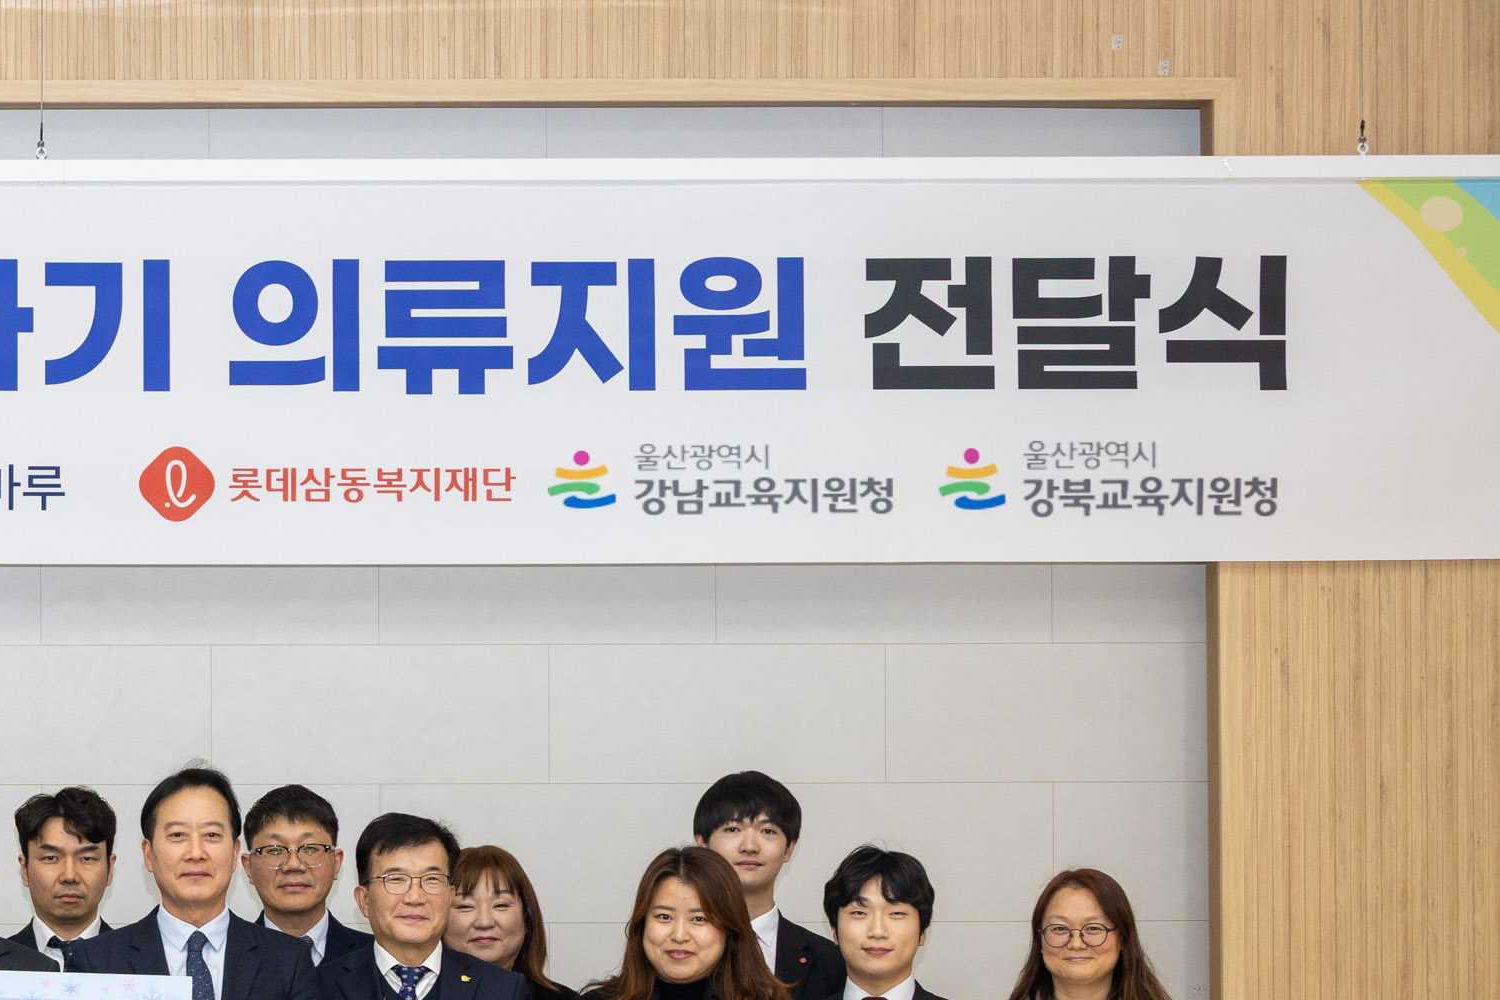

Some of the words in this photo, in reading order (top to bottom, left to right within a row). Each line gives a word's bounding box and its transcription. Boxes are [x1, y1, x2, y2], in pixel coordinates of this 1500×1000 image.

[229, 257, 806, 394] 의류지원
[865, 255, 1287, 390] 전달식
[635, 444, 768, 471] 울산광역시
[1024, 441, 1156, 470] 울산광역시
[229, 467, 516, 503] 롯데삼동복지재단
[635, 477, 893, 515] 강남교육지원청
[1024, 477, 1278, 517] 강북교육지원청
